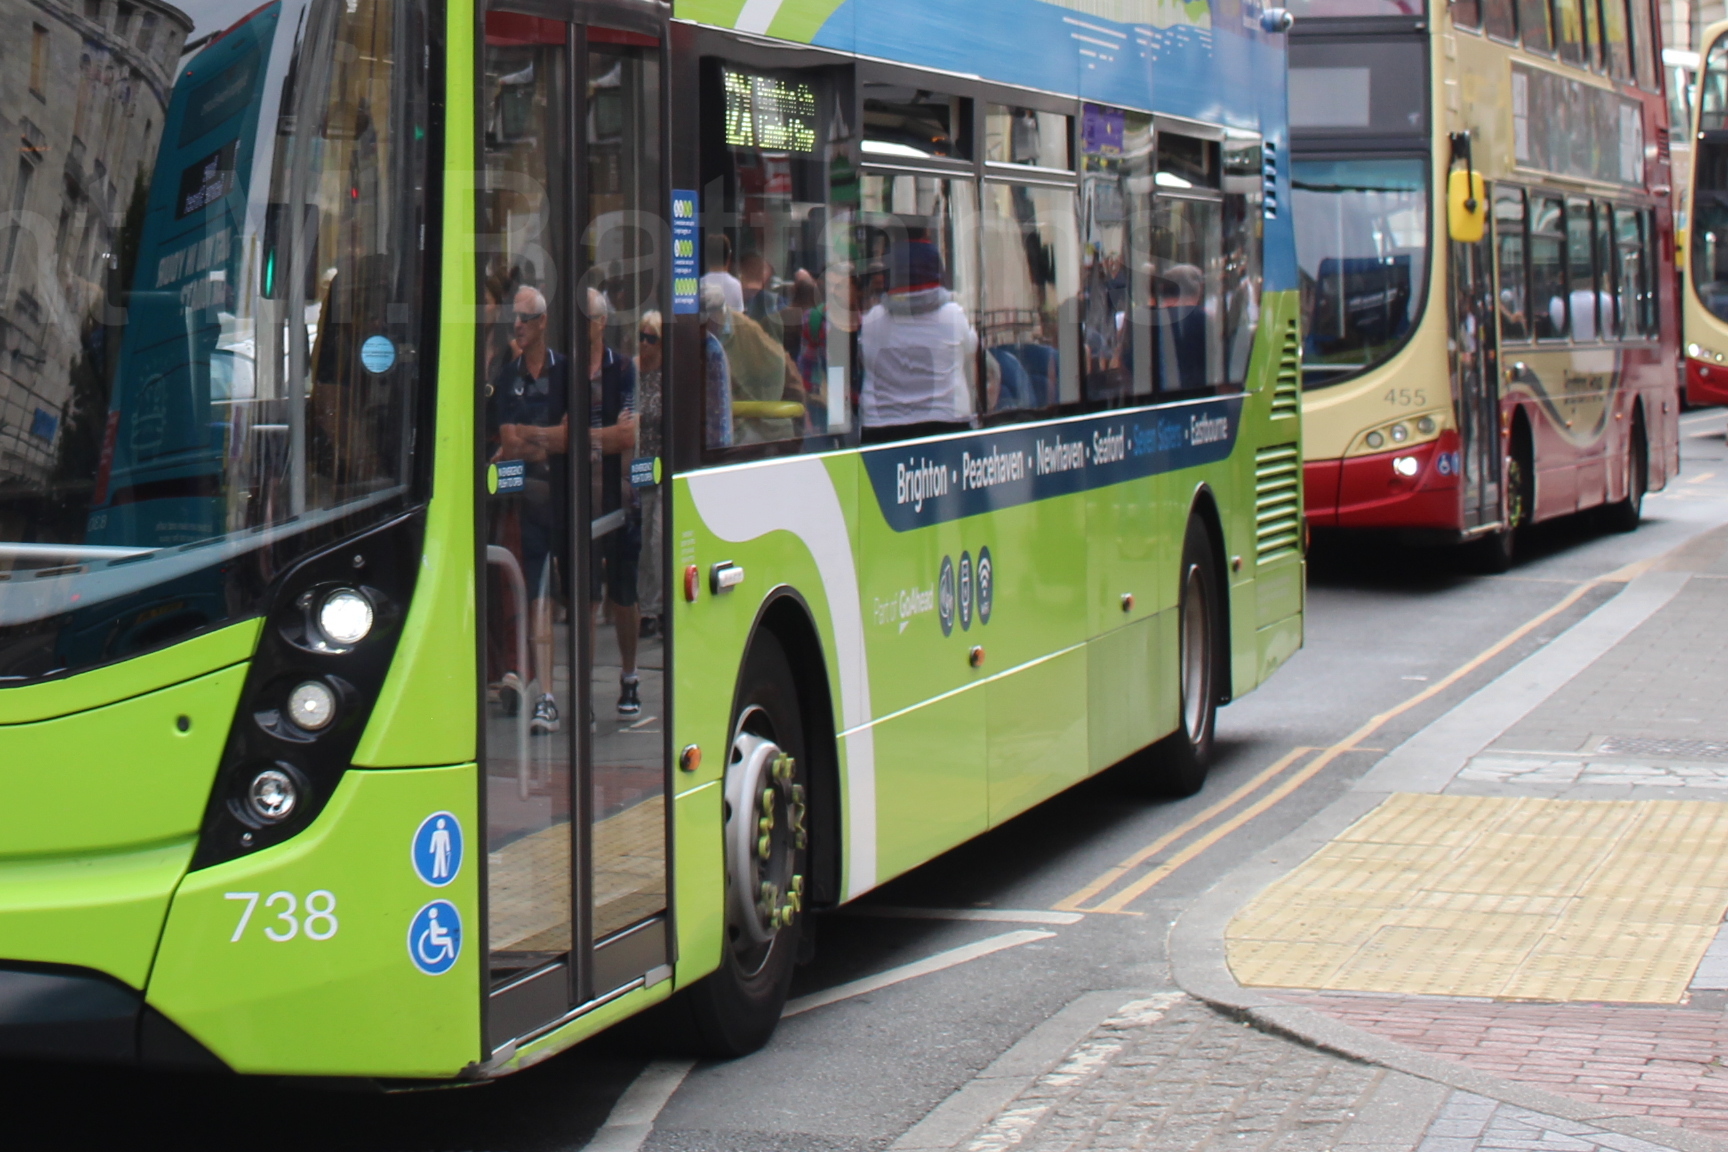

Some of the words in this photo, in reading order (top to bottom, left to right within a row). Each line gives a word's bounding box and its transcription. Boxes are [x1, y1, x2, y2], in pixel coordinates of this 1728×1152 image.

[1384, 388, 1427, 408] 455
[897, 457, 948, 512] Brighton
[962, 445, 1024, 491] Peacehaven
[1036, 435, 1085, 476] Newhaven
[1092, 425, 1125, 466] Seaford
[1190, 412, 1229, 447] Eastbourne
[222, 889, 340, 943] 738
